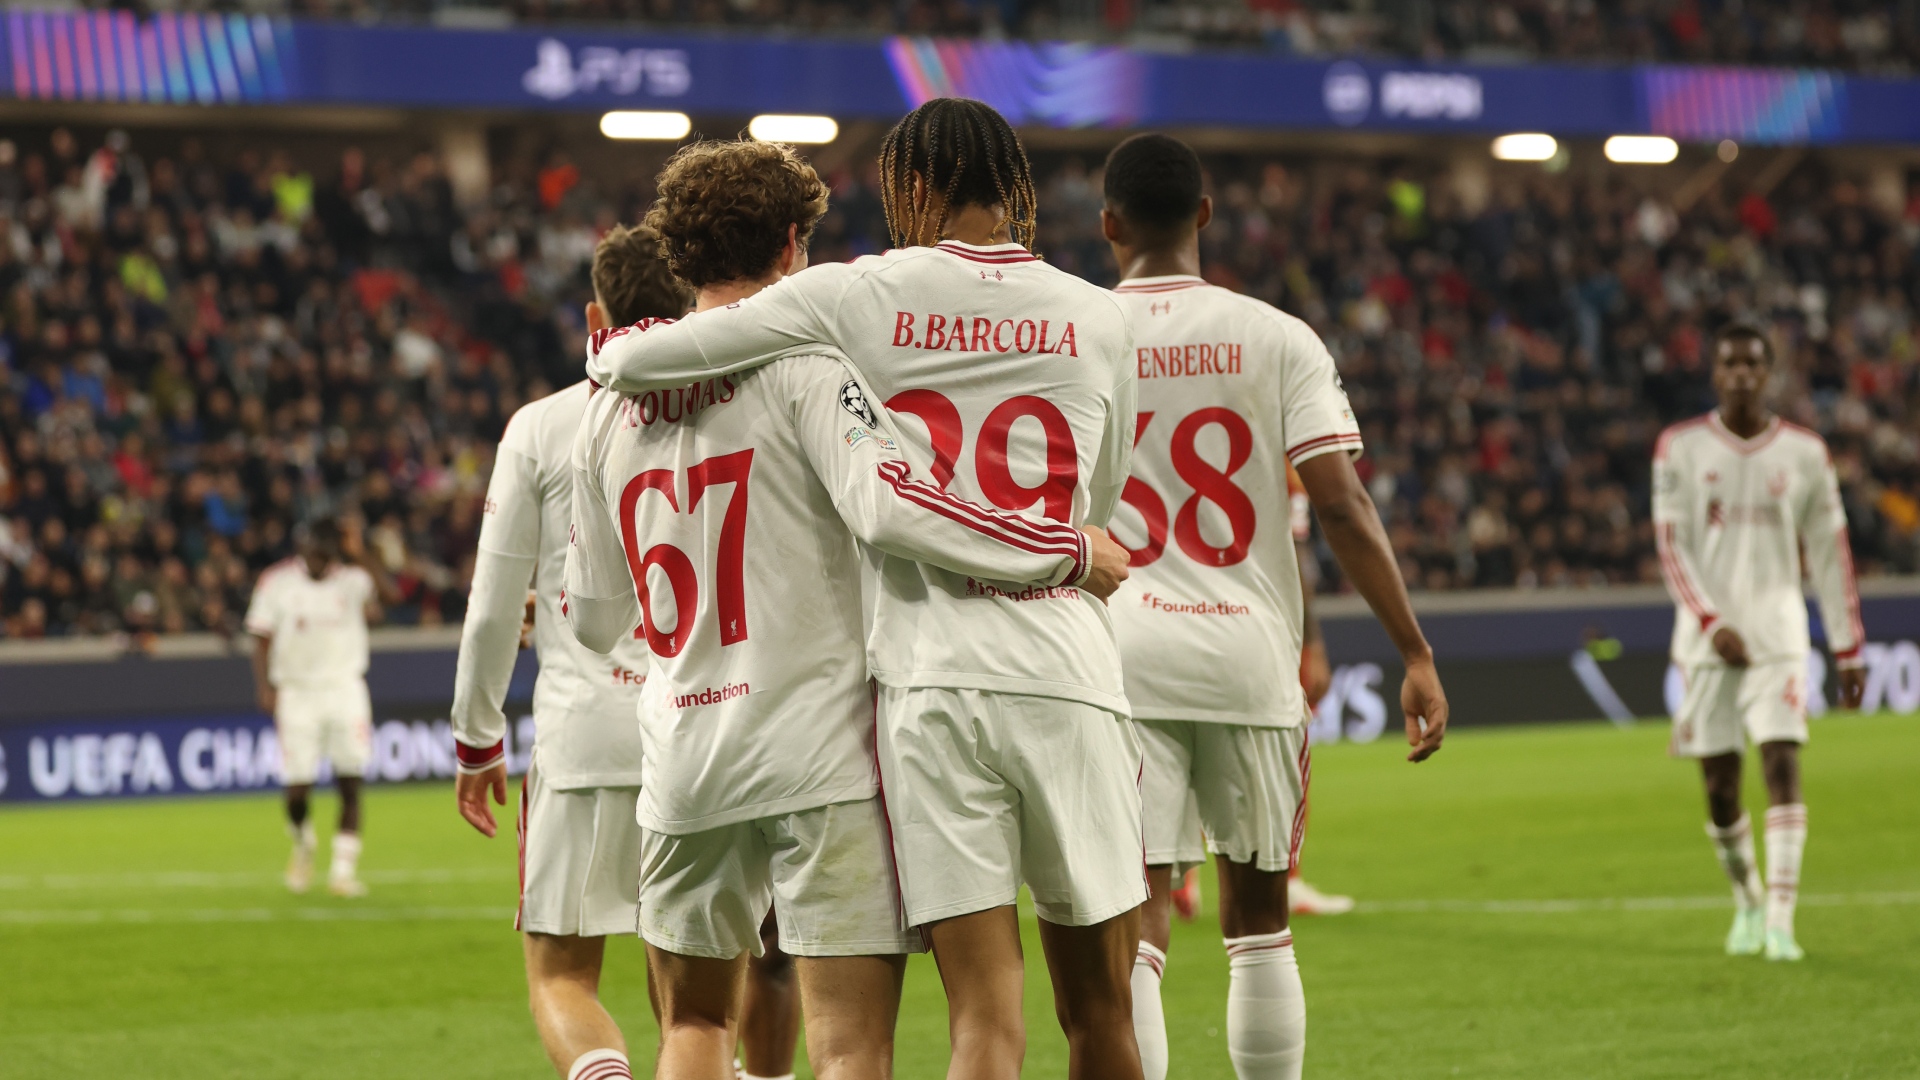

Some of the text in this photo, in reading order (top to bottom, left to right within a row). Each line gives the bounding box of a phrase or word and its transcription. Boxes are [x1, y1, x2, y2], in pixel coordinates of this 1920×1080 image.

[891, 311, 1079, 358] B.BARCOLA
[1137, 343, 1242, 380] ENBERCH
[619, 447, 755, 659] 67
[1151, 596, 1250, 616] Foundation
[665, 682, 750, 709] undation
[28, 731, 174, 798] UEFA
